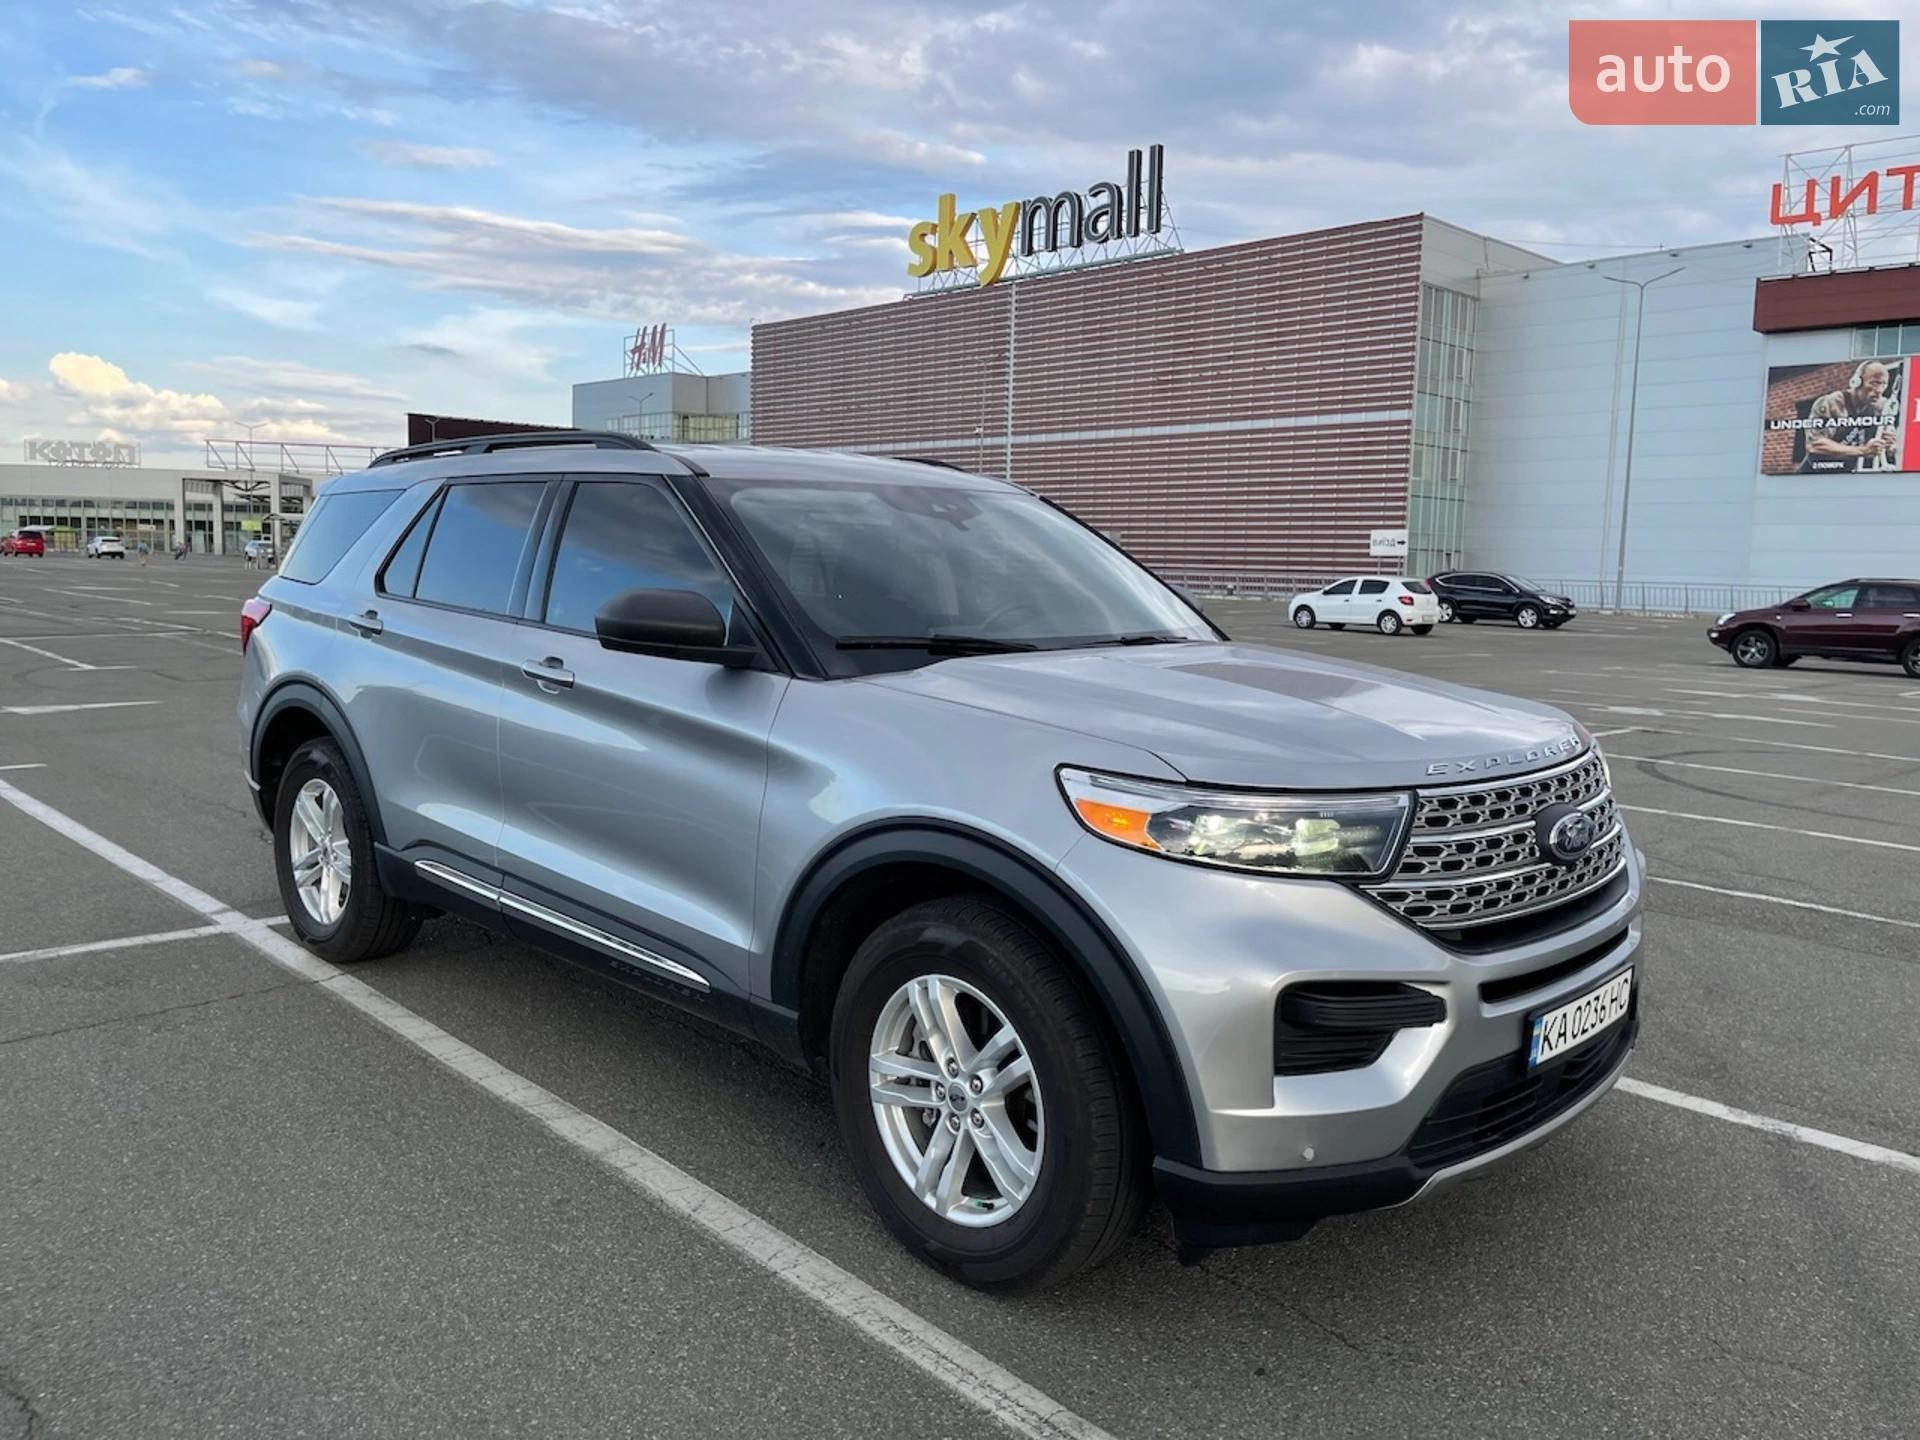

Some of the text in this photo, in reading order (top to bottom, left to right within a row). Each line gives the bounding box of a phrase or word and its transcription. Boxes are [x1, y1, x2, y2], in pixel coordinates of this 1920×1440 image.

[907, 143, 1165, 287] skymall
[1770, 416, 1896, 430] UNDER ARMOUR
[1426, 736, 1580, 776] EXPLORER
